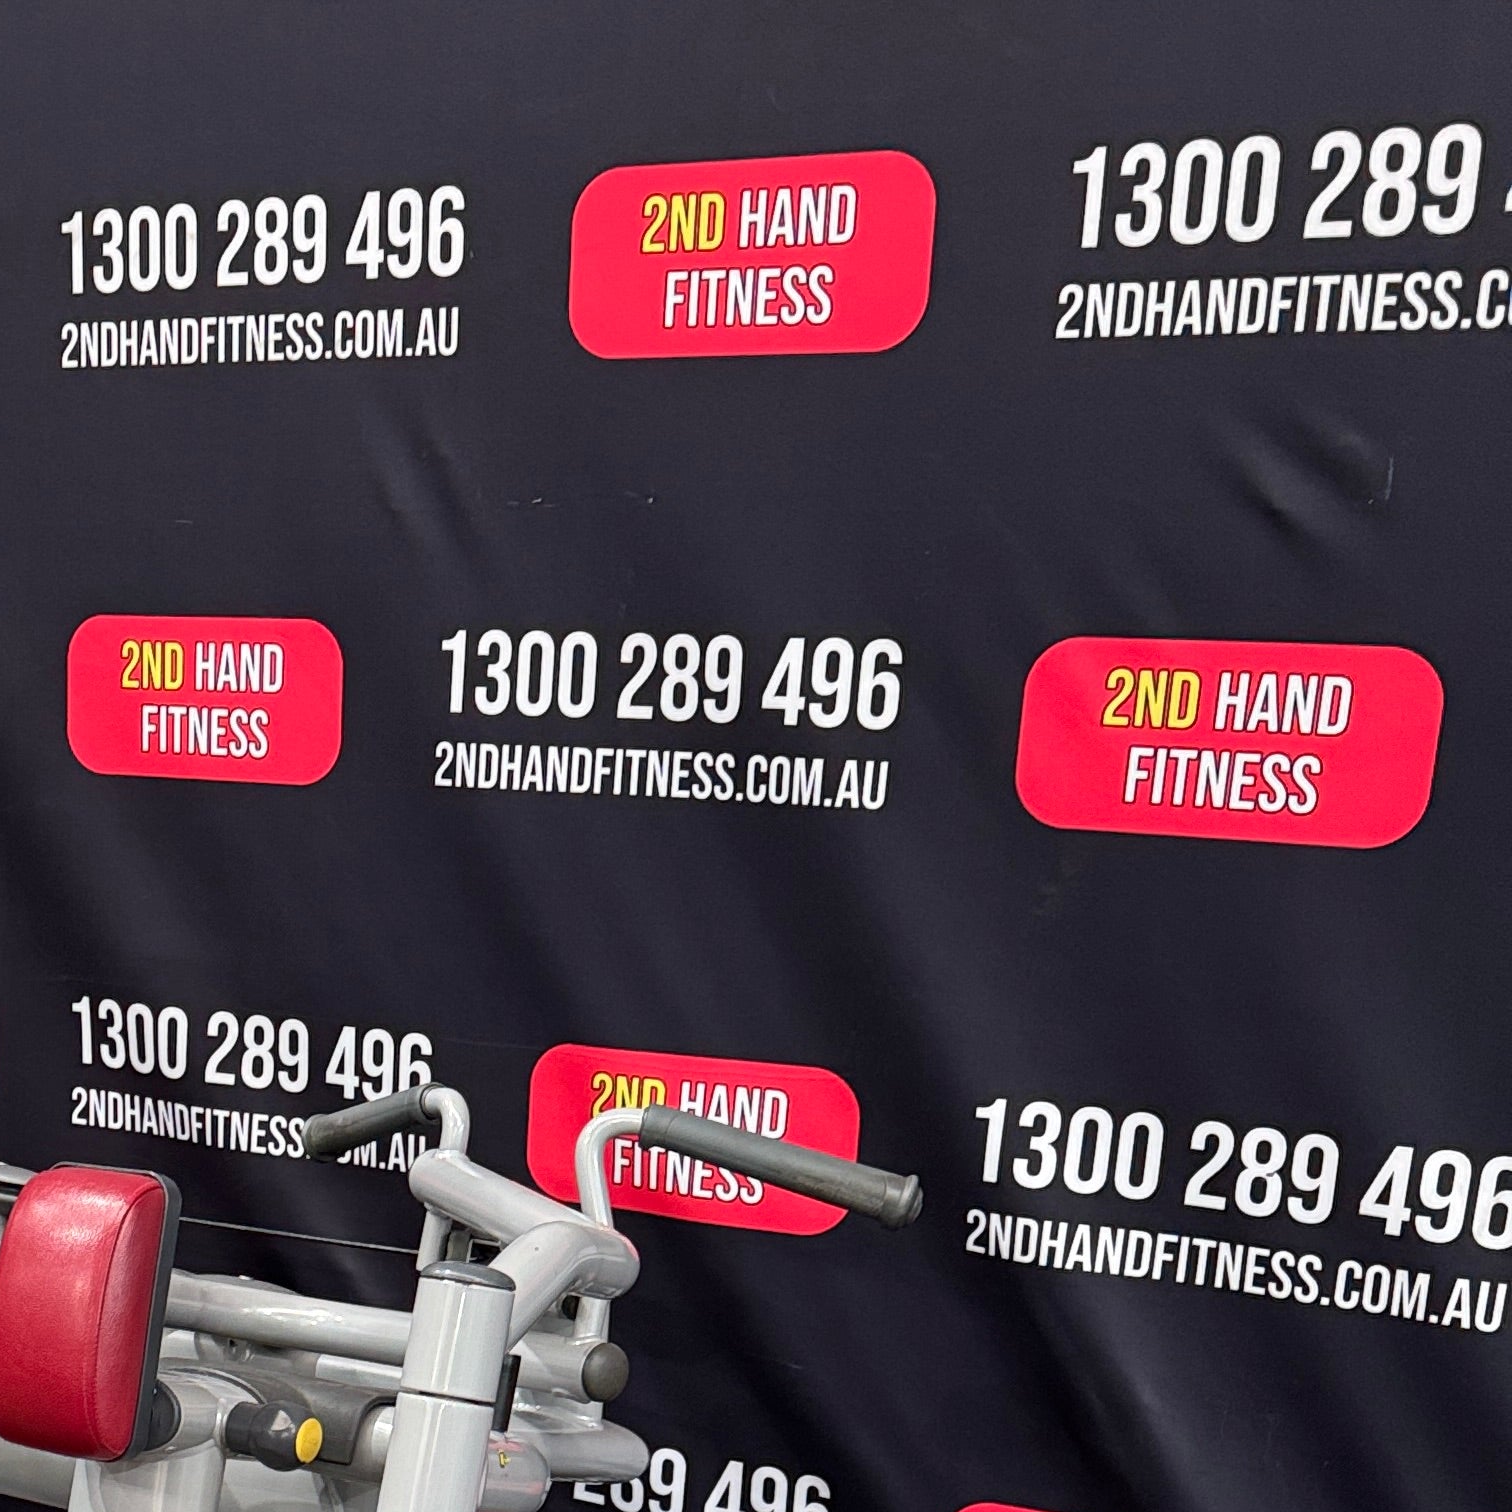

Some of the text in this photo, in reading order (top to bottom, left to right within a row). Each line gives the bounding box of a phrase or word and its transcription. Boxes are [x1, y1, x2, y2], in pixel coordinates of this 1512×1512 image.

[641, 183, 858, 254] 2ND HAND
[1073, 122, 1483, 248] 1300 289
[61, 185, 465, 295] 1300 289 496
[664, 266, 834, 328] FITNESS
[61, 307, 459, 369] 2NDHANDFITNESS.COM.AU
[121, 640, 284, 693] 2ND HAND
[441, 629, 904, 731] 1300 289 496
[141, 705, 269, 759] FITNESS
[1102, 667, 1353, 736] 2ND HAND
[434, 741, 889, 810] 2NDHANDFITNESS.COM.AU
[1124, 747, 1321, 815] FITNESS
[72, 995, 433, 1102] 1300 289 496
[680, 1080, 788, 1139] HAND
[975, 1098, 1512, 1250] 1300 289 496
[966, 1208, 1508, 1333] 2NDHANDFITNESS.COM.AU
